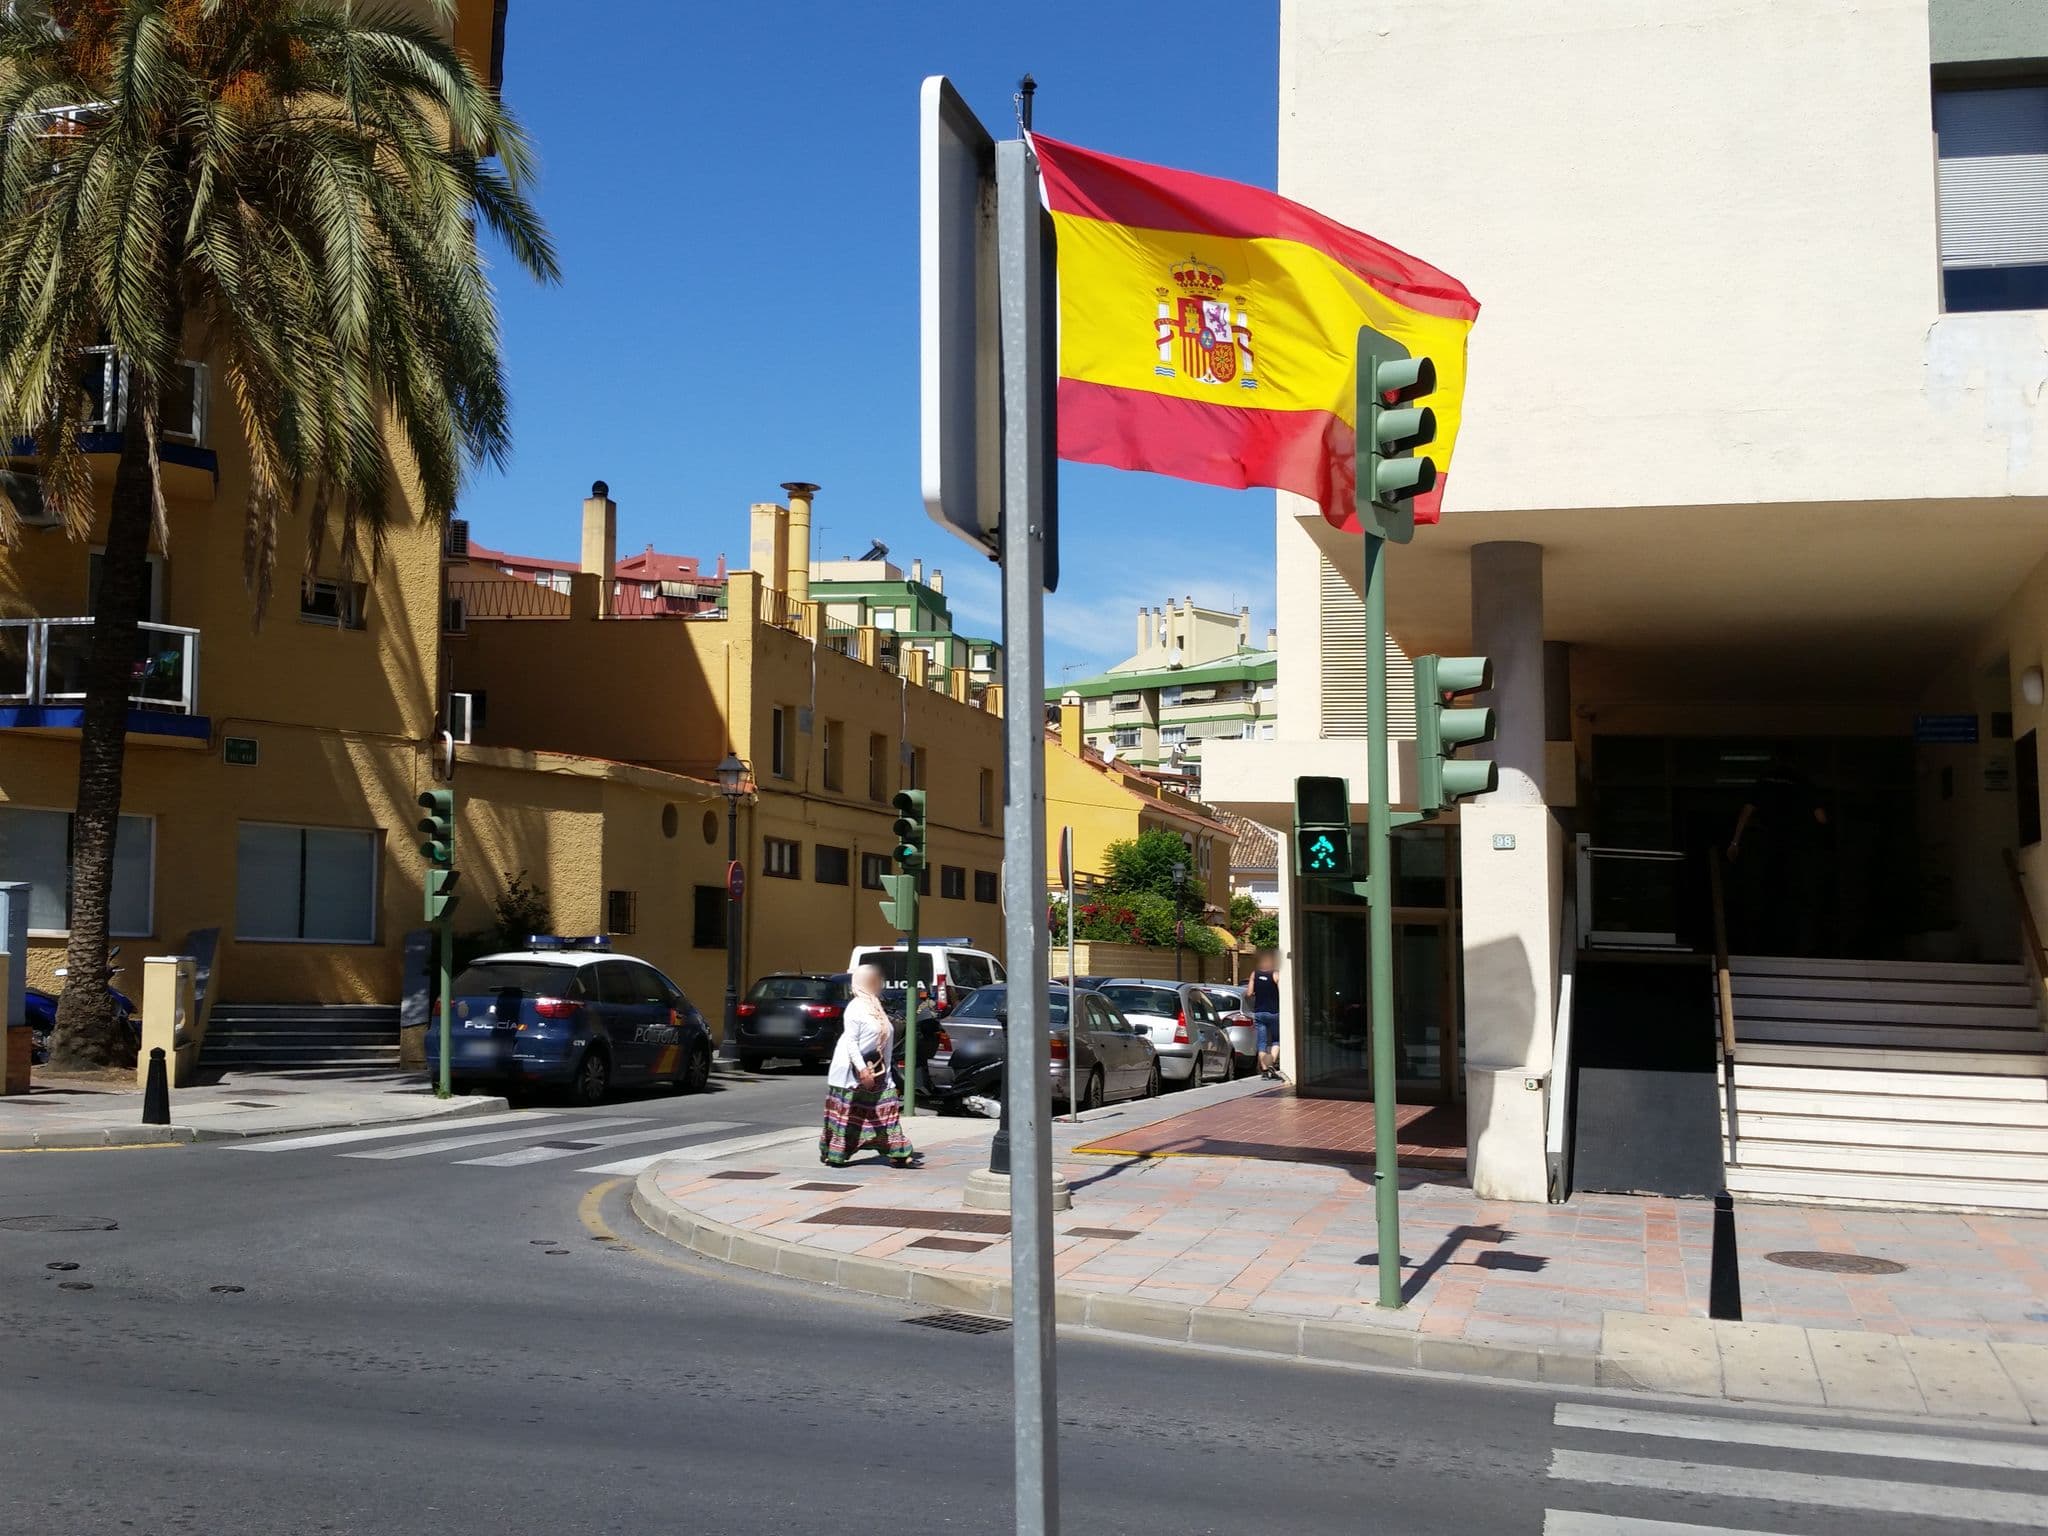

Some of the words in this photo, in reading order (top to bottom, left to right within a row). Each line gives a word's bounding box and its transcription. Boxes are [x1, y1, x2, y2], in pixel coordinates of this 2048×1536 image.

[881, 980, 926, 990] LICA
[464, 1020, 518, 1030] POLCÍA
[634, 1027, 680, 1044] POICA
